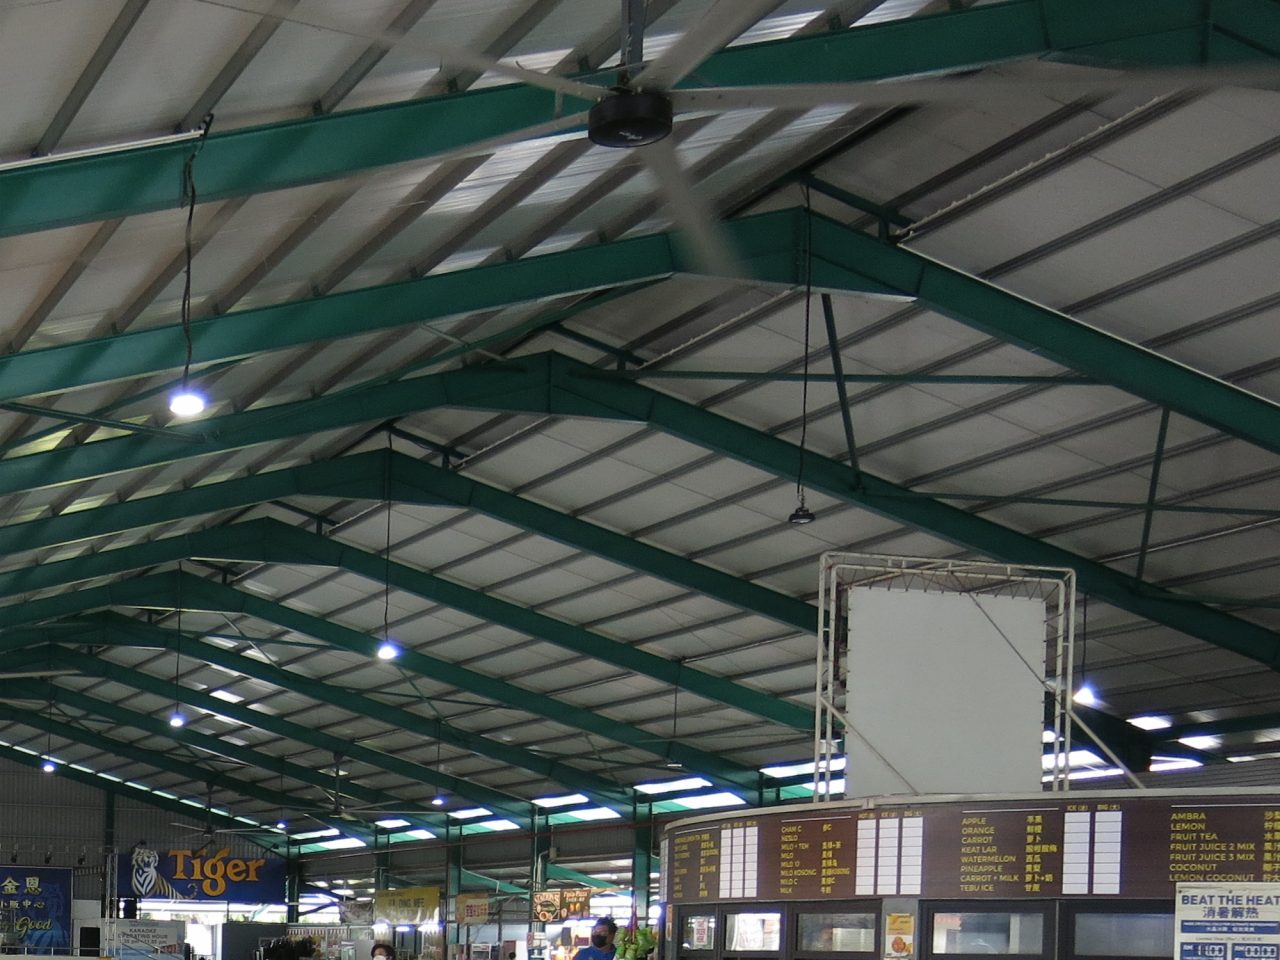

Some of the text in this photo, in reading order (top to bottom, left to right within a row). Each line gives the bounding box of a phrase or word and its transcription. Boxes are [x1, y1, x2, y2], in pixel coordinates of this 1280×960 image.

[1171, 812, 1206, 820] AMBRA
[1170, 823, 1206, 831] LEMON
[961, 836, 993, 844] CARROT
[1170, 853, 1255, 861] FRUIT JUICE 3 MIX
[1169, 863, 1217, 871] COCONUT
[168, 848, 265, 897] Tiger
[960, 874, 992, 882] CARROT
[0, 876, 42, 895] 金恩
[960, 884, 980, 892] TEBU
[1182, 895, 1280, 906] BEAT THE HEAT
[16, 916, 53, 939] Good
